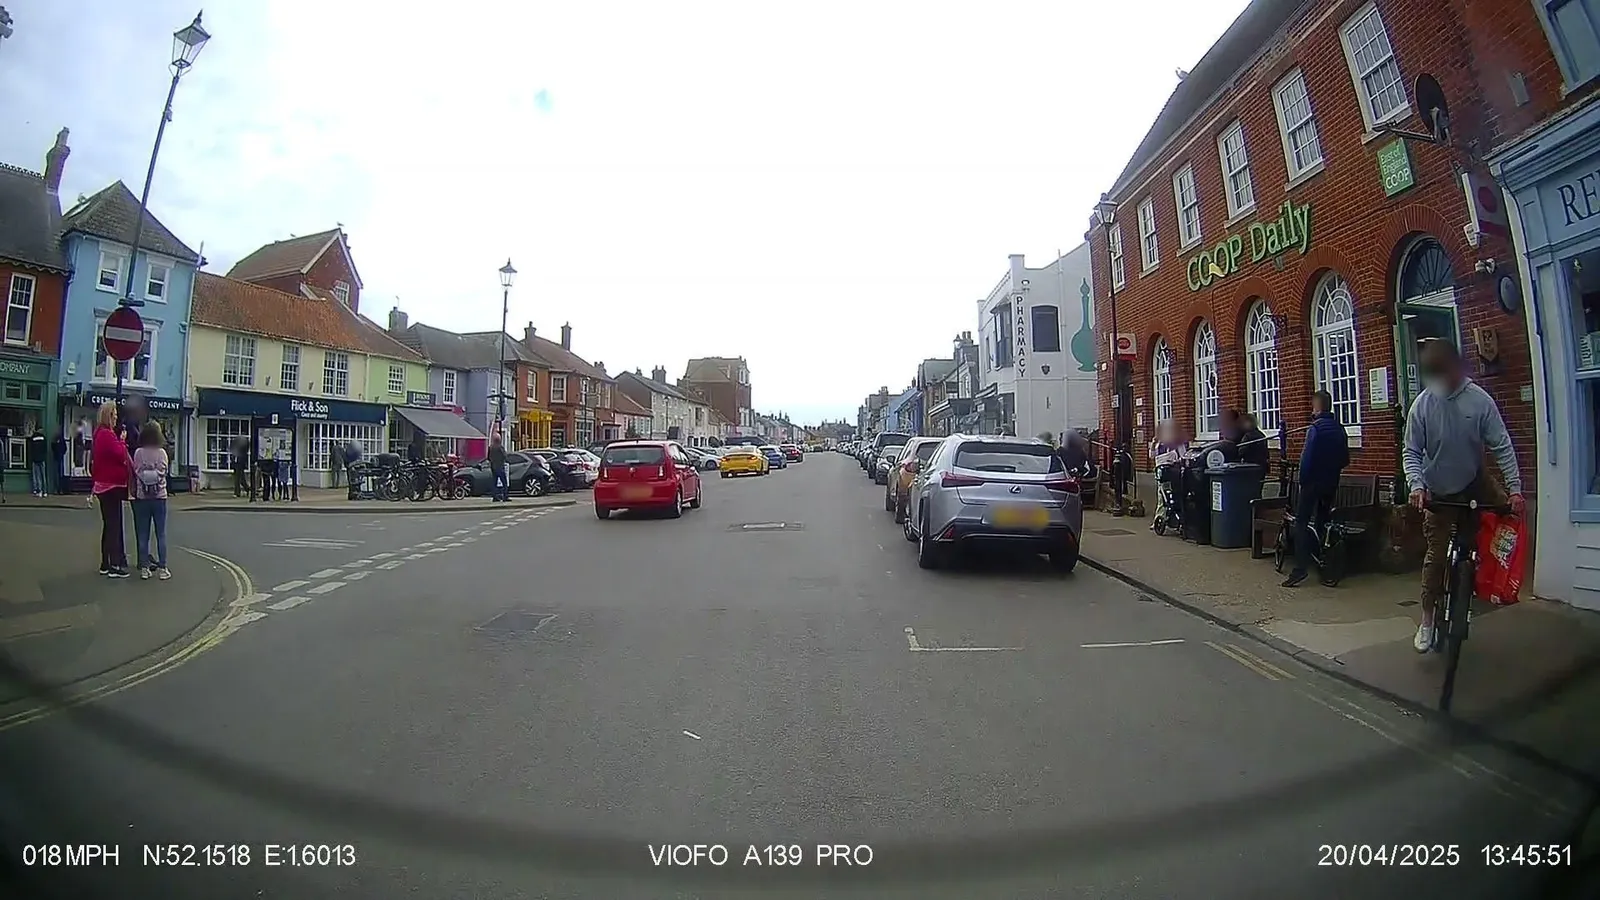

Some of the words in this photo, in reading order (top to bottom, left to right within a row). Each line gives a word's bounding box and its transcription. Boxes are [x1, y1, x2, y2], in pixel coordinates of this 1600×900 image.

[1556, 170, 1600, 227] RE
[1247, 199, 1310, 263] Daily
[1016, 295, 1026, 378] PHARMACY
[148, 400, 180, 410] COMPANY
[291, 400, 307, 411] Flick
[308, 401, 314, 411] &
[315, 401, 329, 413] Son
